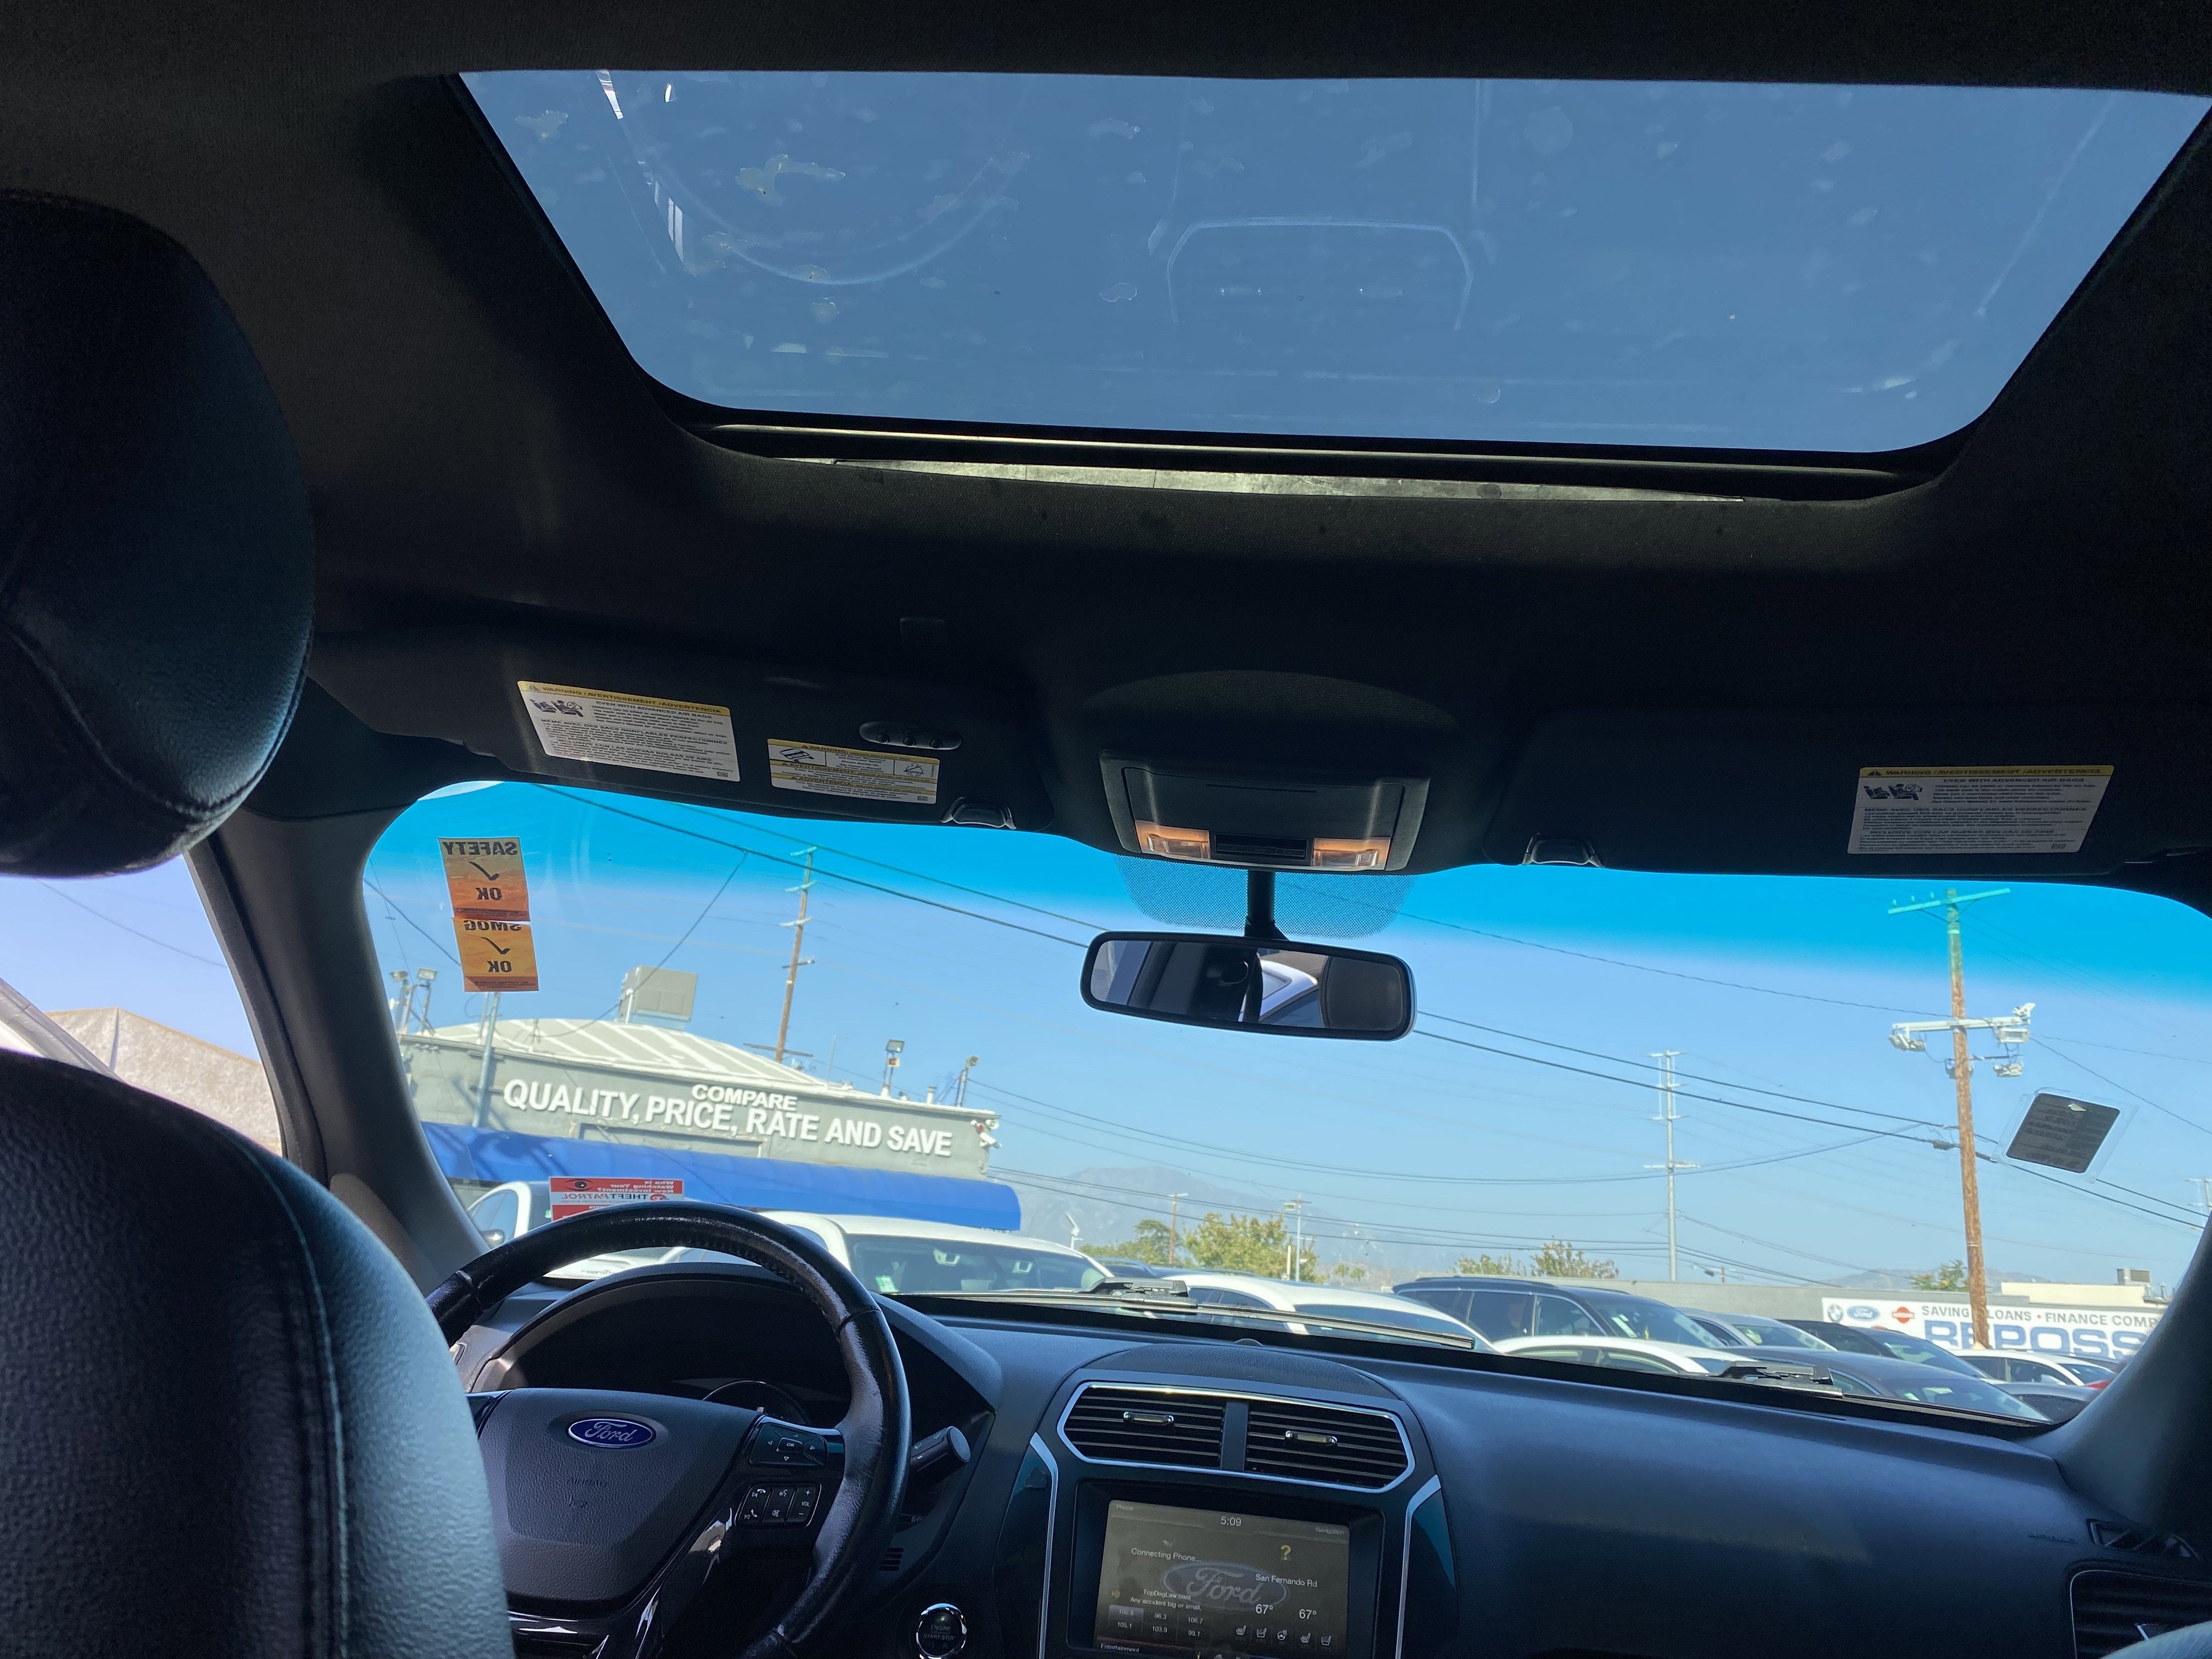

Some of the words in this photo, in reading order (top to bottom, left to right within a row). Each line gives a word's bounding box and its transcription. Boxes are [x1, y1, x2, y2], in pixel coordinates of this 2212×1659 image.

[541, 686, 583, 696] WARNING
[691, 1083, 798, 1113] COMPARE
[503, 1078, 641, 1126] QUALITY,
[645, 1095, 739, 1138] PRICE,
[745, 1107, 821, 1142] RATE
[825, 1119, 882, 1149] AND
[886, 1125, 953, 1158] SAVE
[2045, 1312, 2108, 1325] FINANCE
[584, 1421, 637, 1442] Ford
[1220, 1516, 1242, 1527] 5:09
[1131, 1548, 1171, 1560] Connecting
[1185, 1565, 1263, 1606] Ford
[1255, 1573, 1269, 1583] San
[1271, 1576, 1305, 1587] Fernando
[1307, 1579, 1318, 1588] Rd
[1130, 1596, 1142, 1605] Any
[1255, 1604, 1274, 1615] 67°
[1299, 1609, 1317, 1620] 67°
[1100, 1643, 1140, 1654] Entertainment
